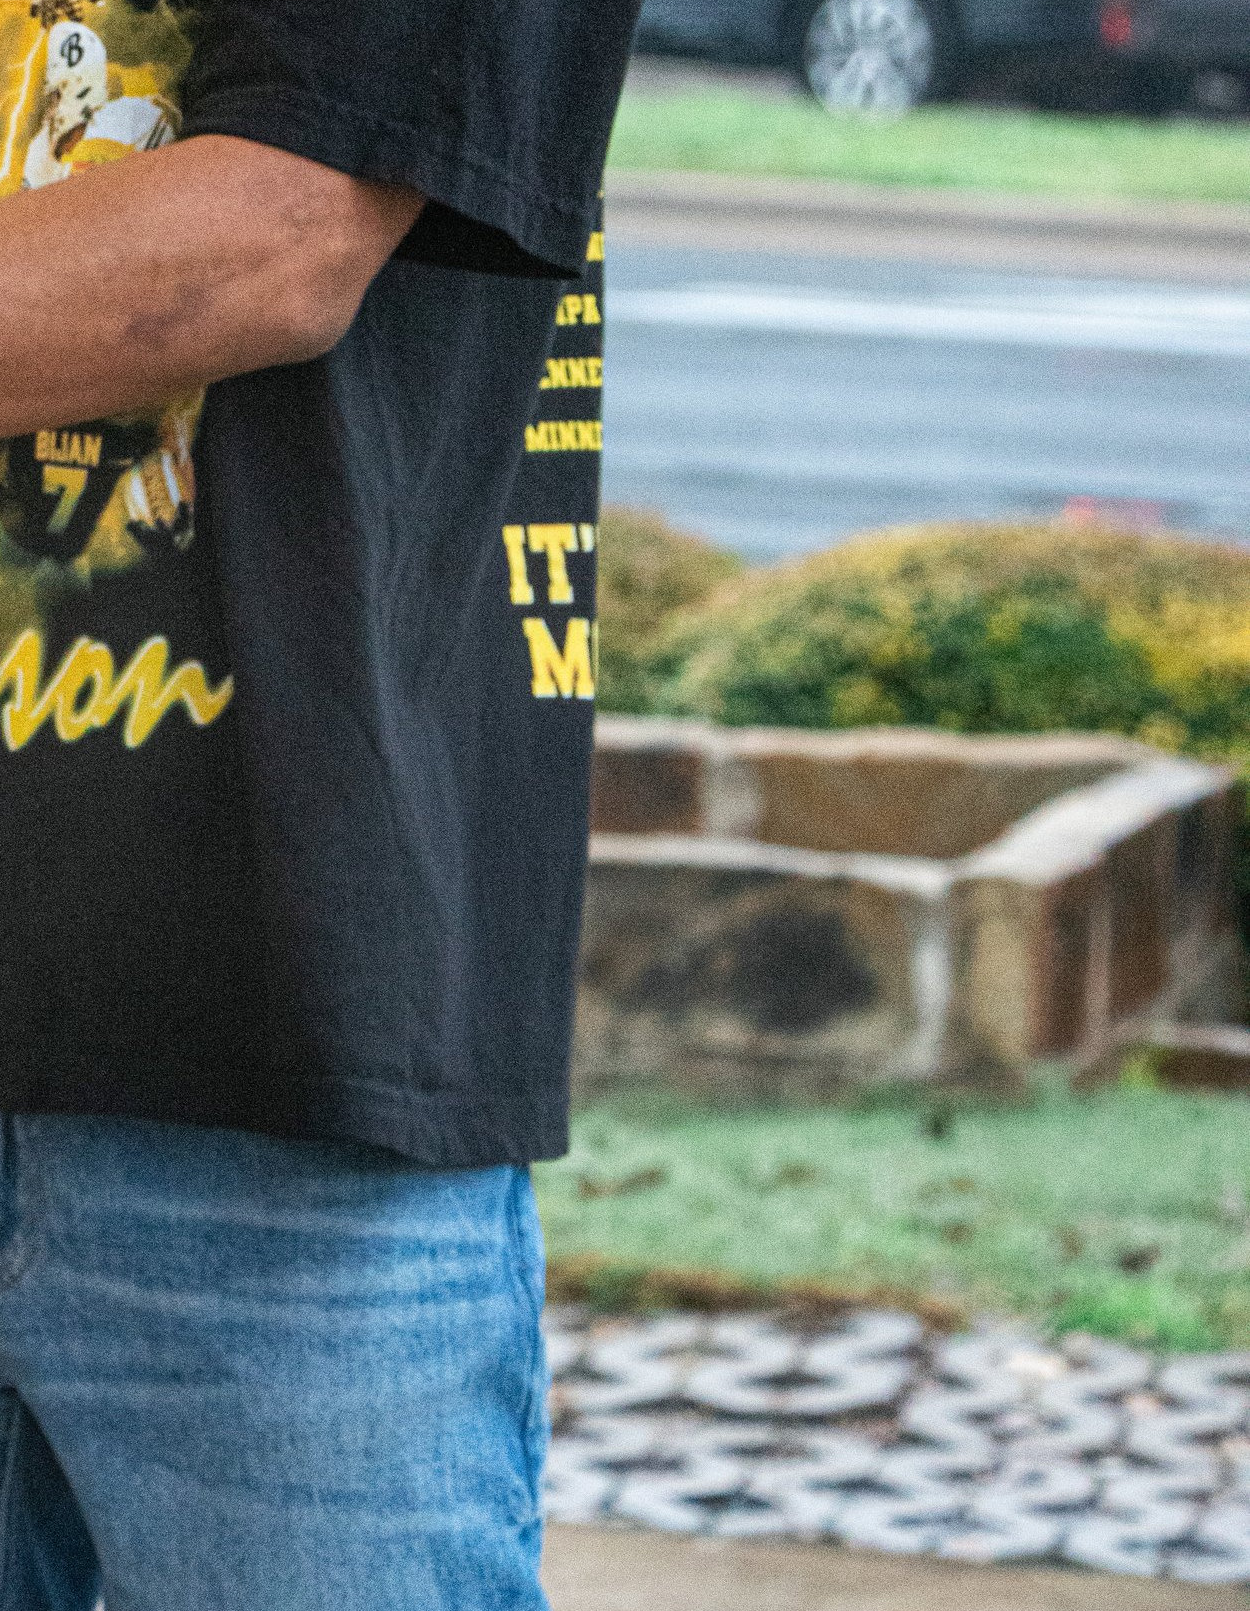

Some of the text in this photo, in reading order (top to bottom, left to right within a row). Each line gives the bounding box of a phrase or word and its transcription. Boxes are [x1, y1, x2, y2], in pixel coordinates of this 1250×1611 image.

[60, 32, 84, 68] B
[34, 429, 102, 466] BIJAN
[42, 465, 87, 534] 7
[522, 617, 598, 701] M
